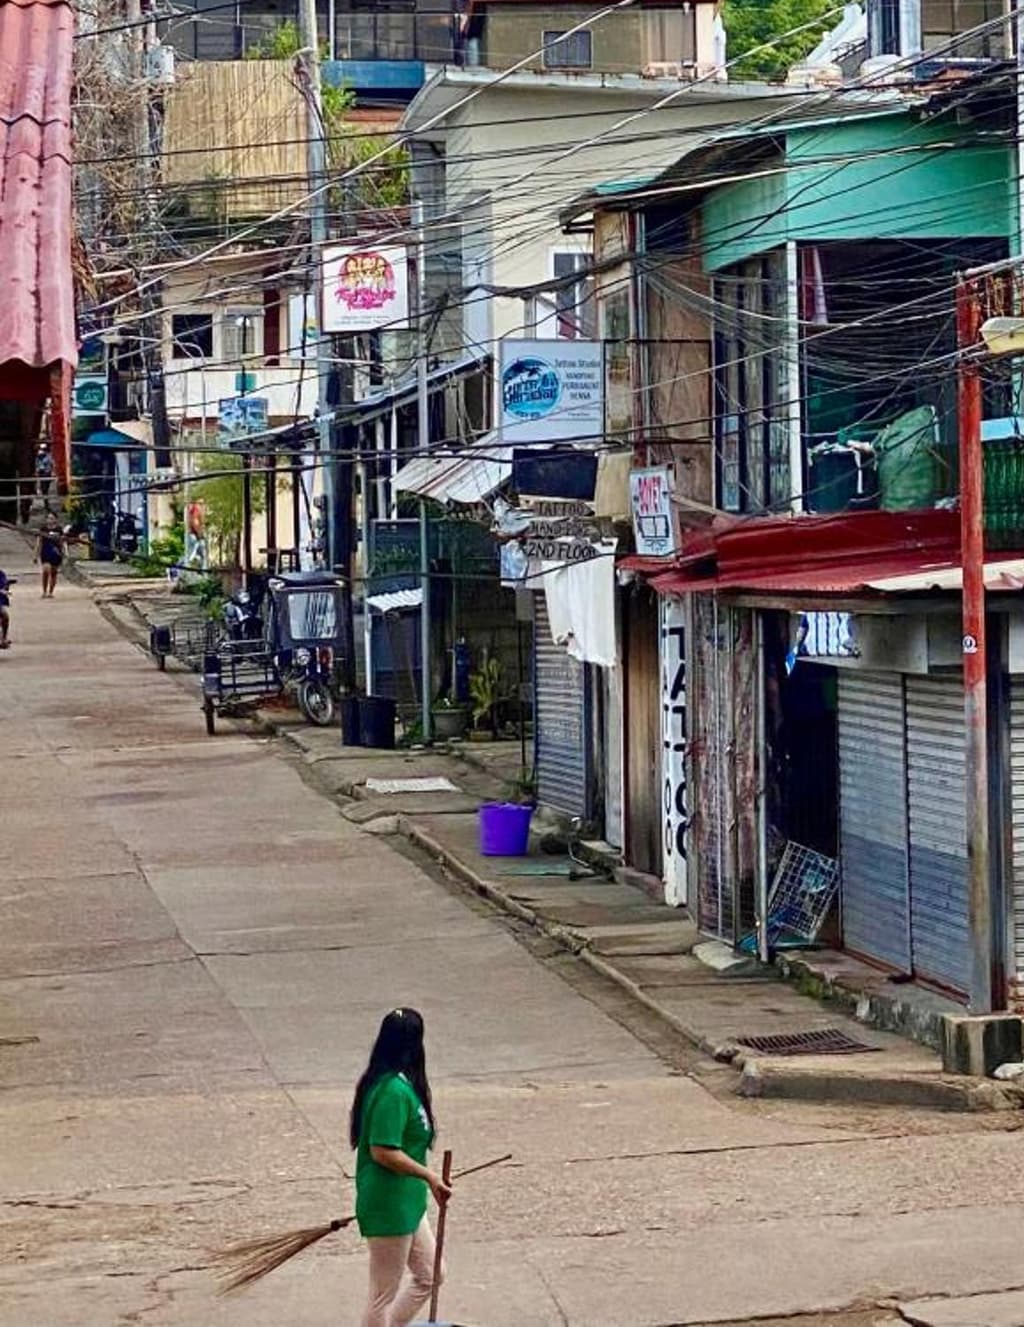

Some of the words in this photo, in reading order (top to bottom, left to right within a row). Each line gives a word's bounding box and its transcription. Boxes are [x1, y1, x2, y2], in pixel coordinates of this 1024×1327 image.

[537, 502, 585, 516] TATTOO
[528, 542, 555, 558] 2ND
[559, 542, 597, 560] FLOOR
